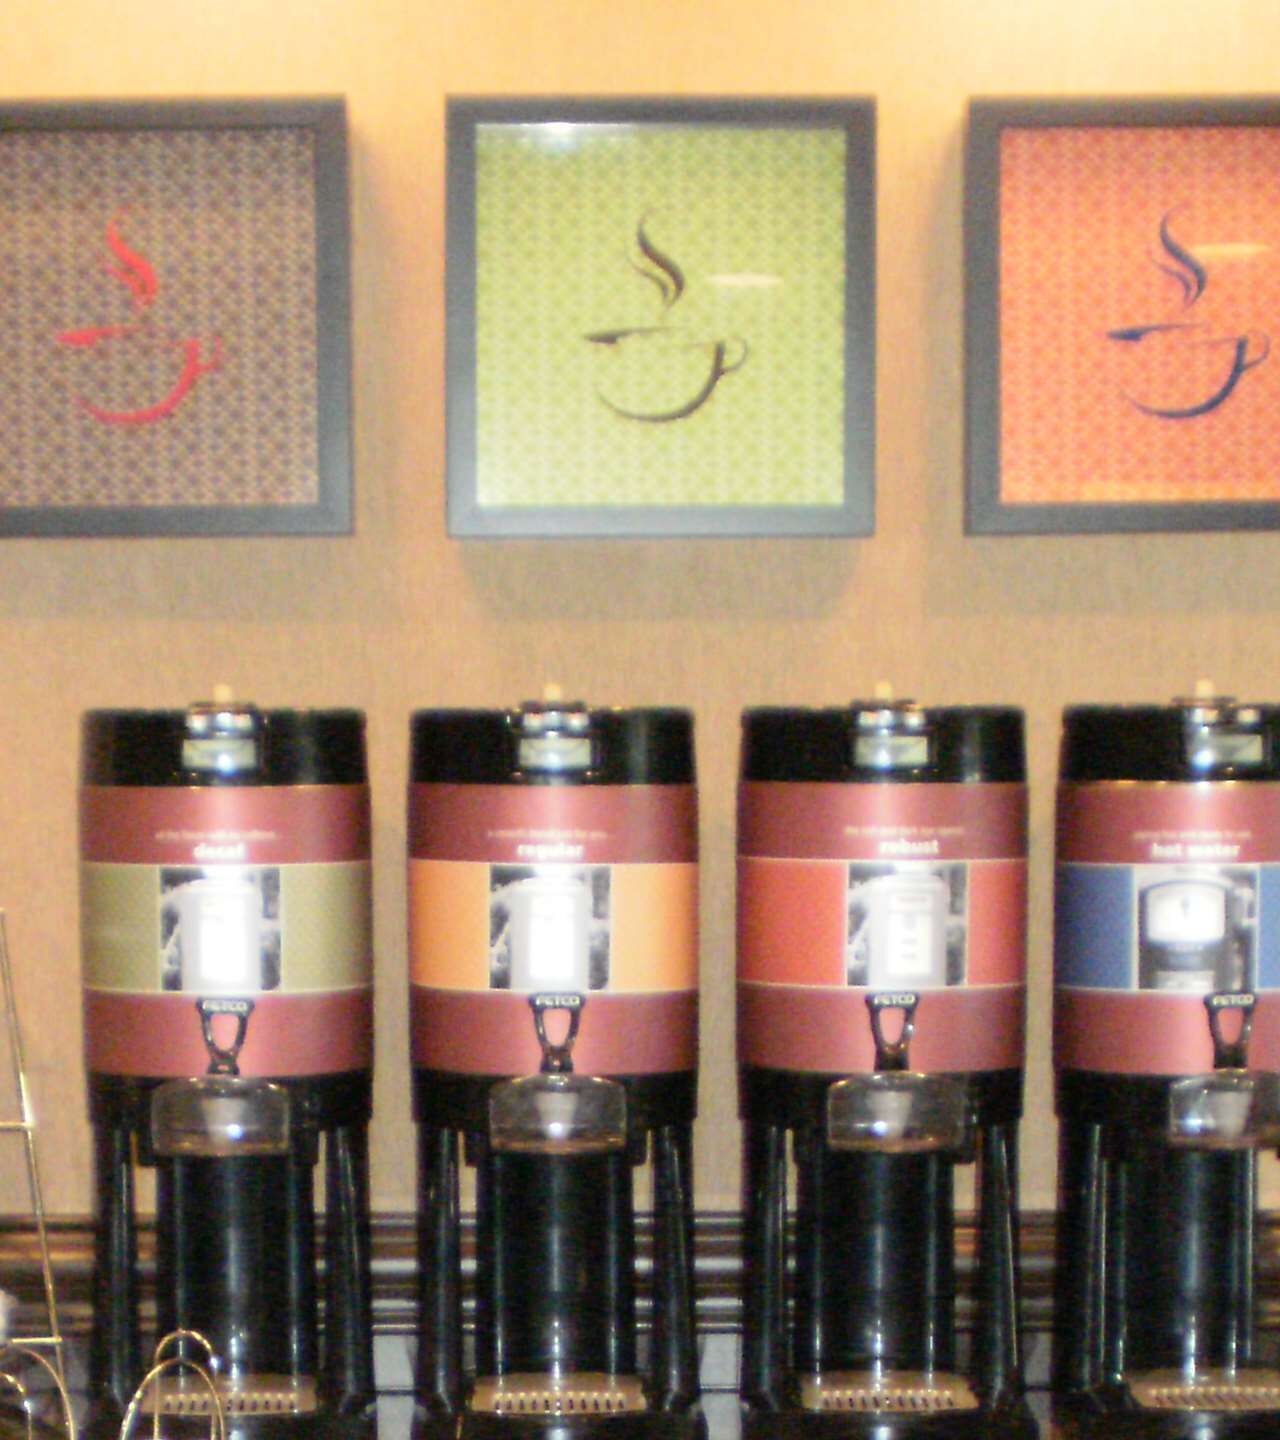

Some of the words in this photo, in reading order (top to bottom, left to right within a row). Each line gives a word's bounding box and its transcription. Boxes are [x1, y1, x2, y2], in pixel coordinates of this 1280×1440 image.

[516, 842, 584, 861] regular
[877, 838, 940, 856] robust
[1151, 843, 1183, 858] hot
